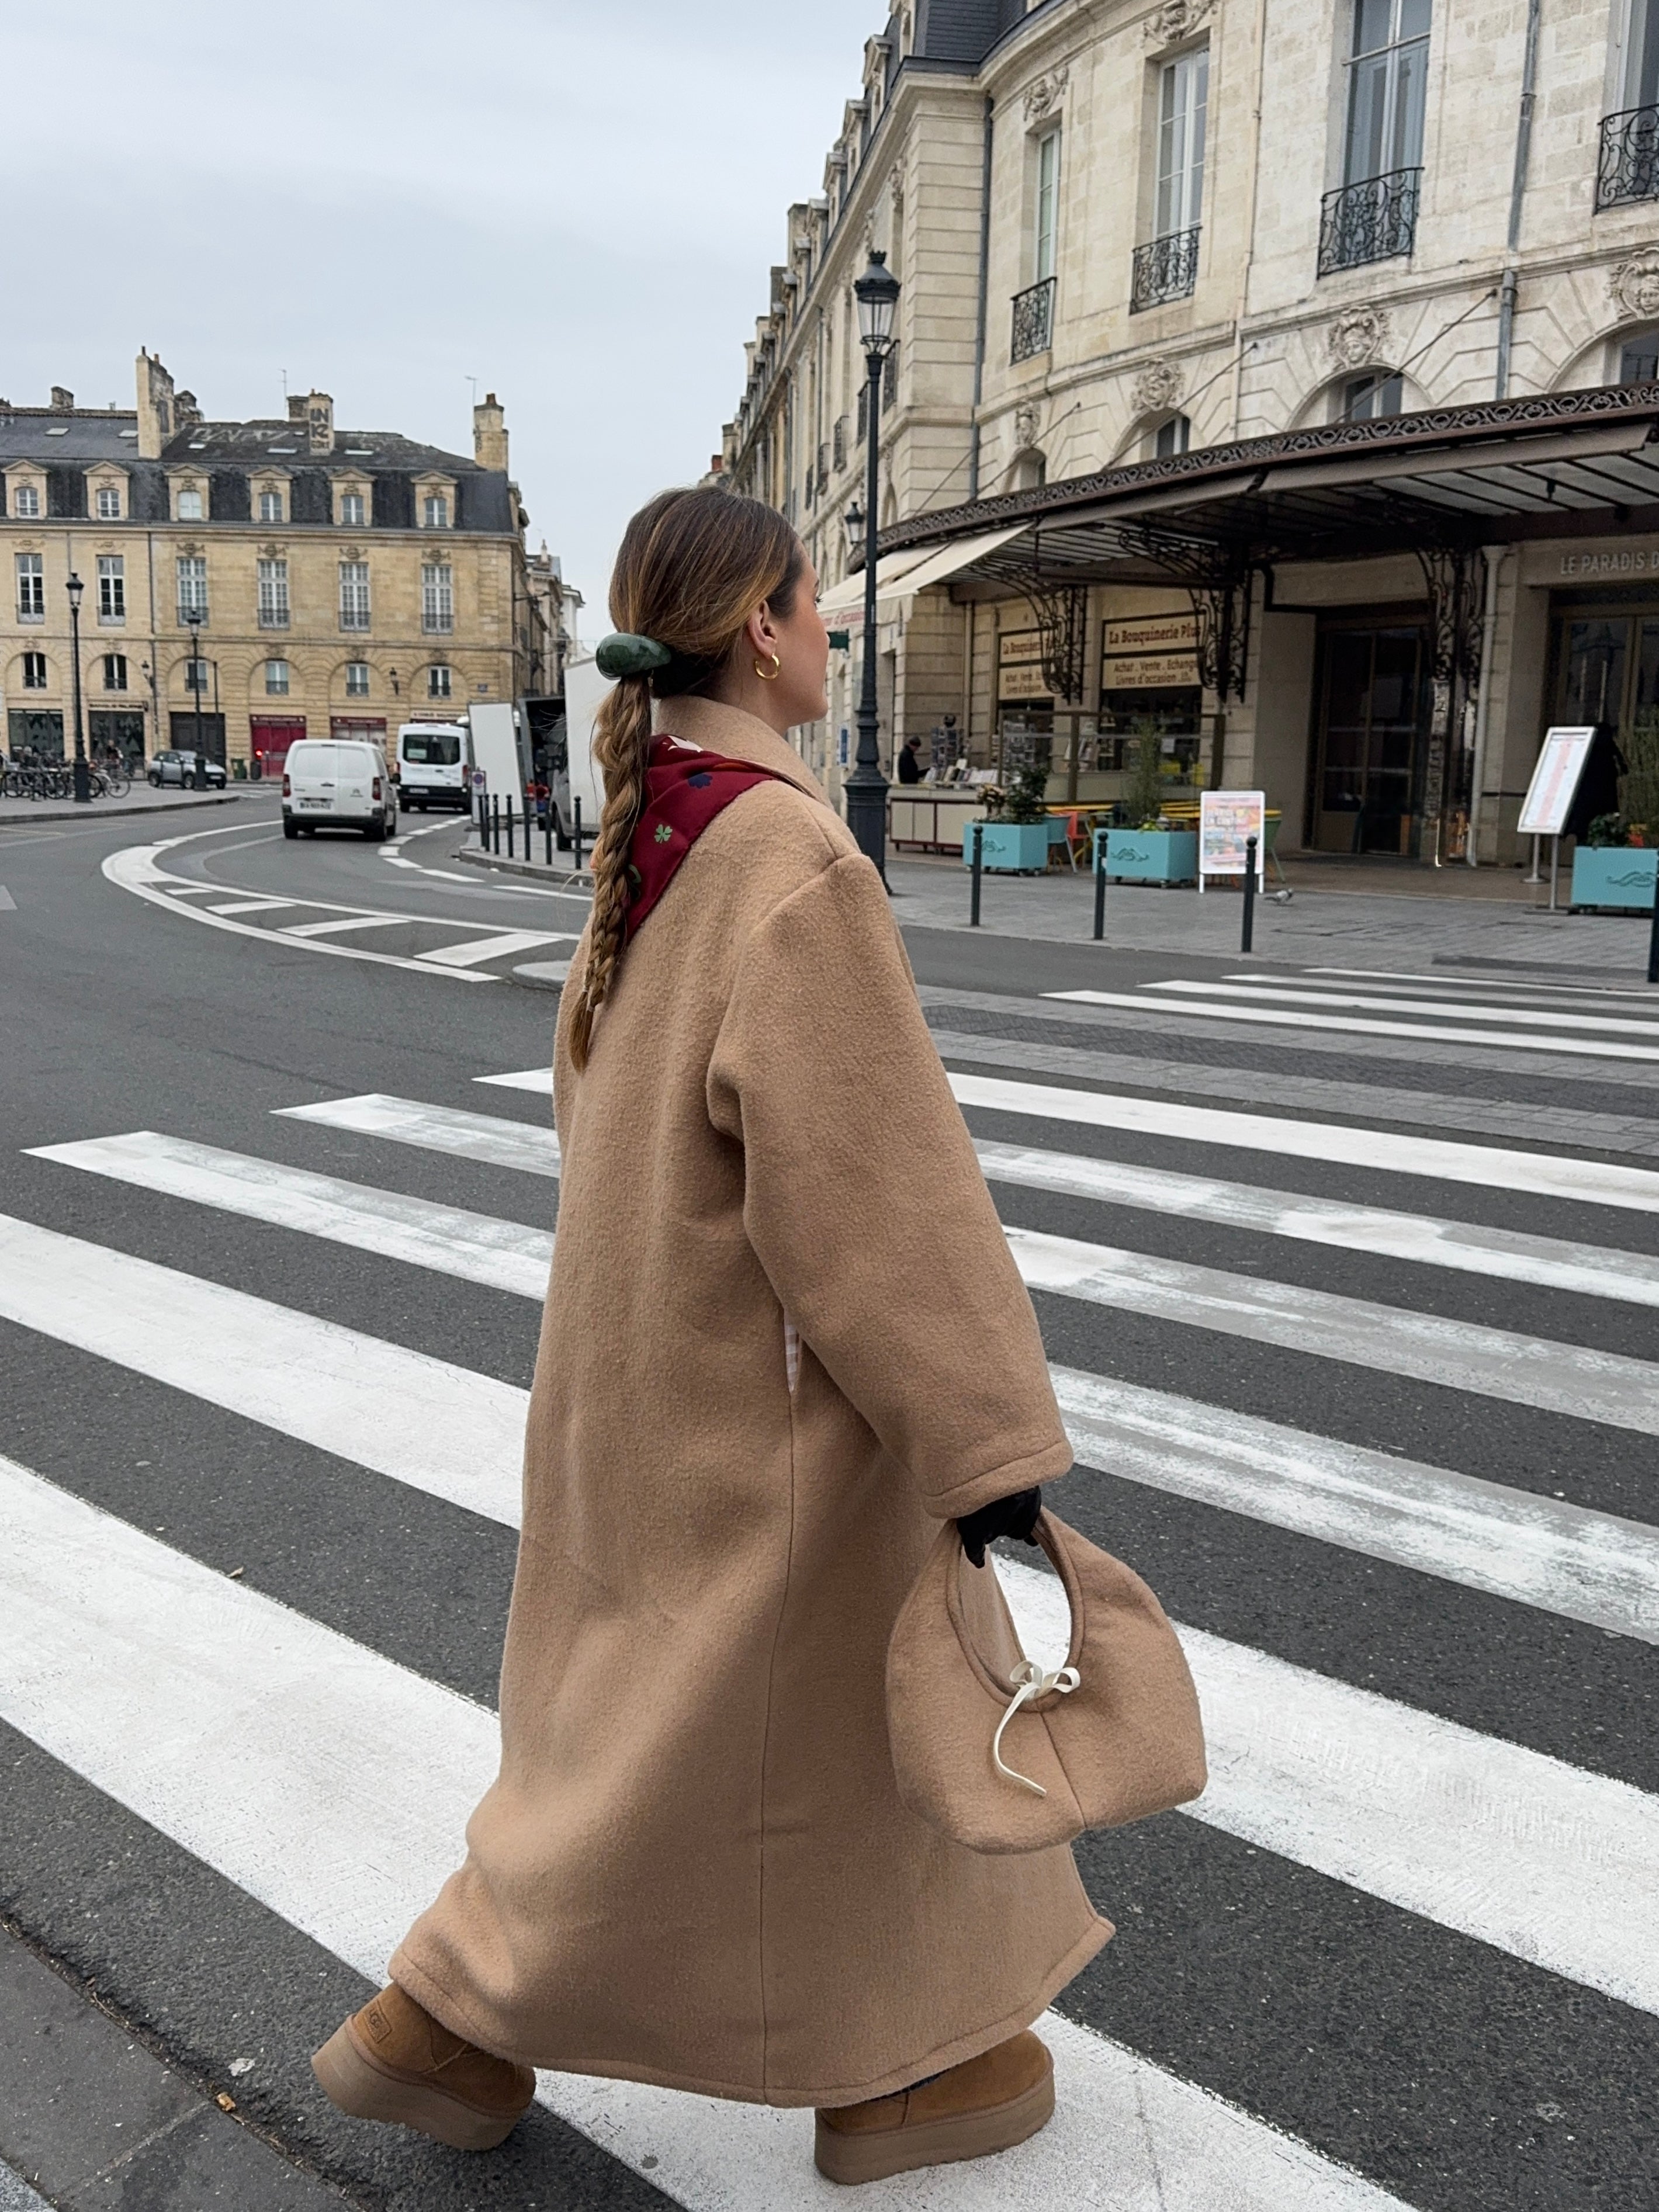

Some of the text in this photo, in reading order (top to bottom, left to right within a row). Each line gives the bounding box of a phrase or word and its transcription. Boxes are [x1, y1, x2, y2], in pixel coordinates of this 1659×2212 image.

[1561, 556, 1575, 575] LE
[1581, 552, 1645, 573] PARADIS
[1109, 631, 1118, 644] La
[1121, 624, 1178, 646] Bouquinerie
[1140, 661, 1160, 671] Vente
